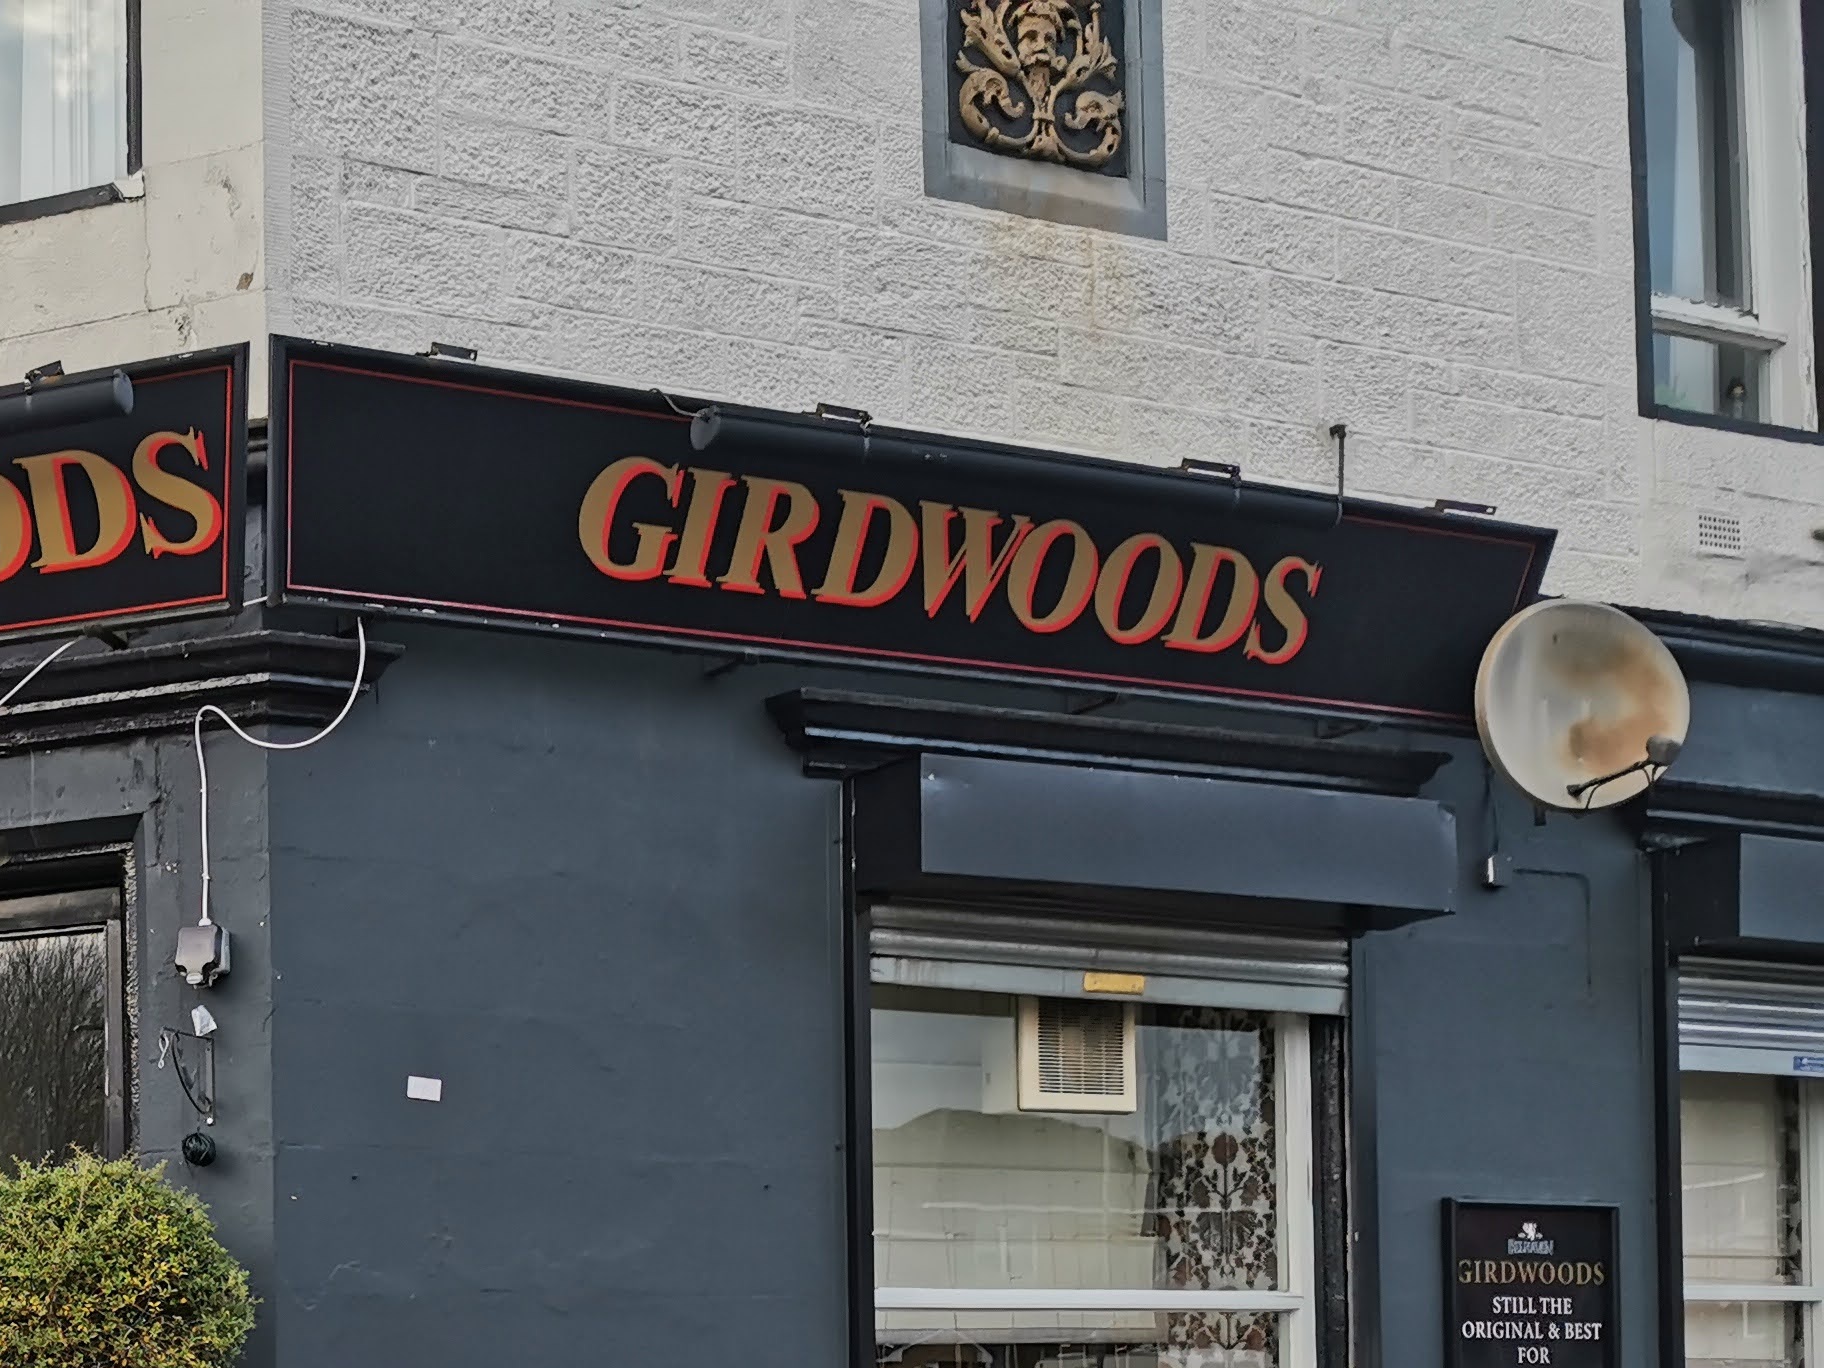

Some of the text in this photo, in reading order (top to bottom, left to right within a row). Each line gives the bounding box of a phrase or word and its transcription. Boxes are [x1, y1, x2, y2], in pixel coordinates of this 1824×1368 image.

[578, 455, 1323, 665] GIRDWOODS
[1458, 1260, 1605, 1286] GIRDWOODS
[1492, 1296, 1573, 1315] STILL THE
[1462, 1321, 1602, 1340] ORIGINAL & BEST
[1517, 1346, 1551, 1364] FOR
